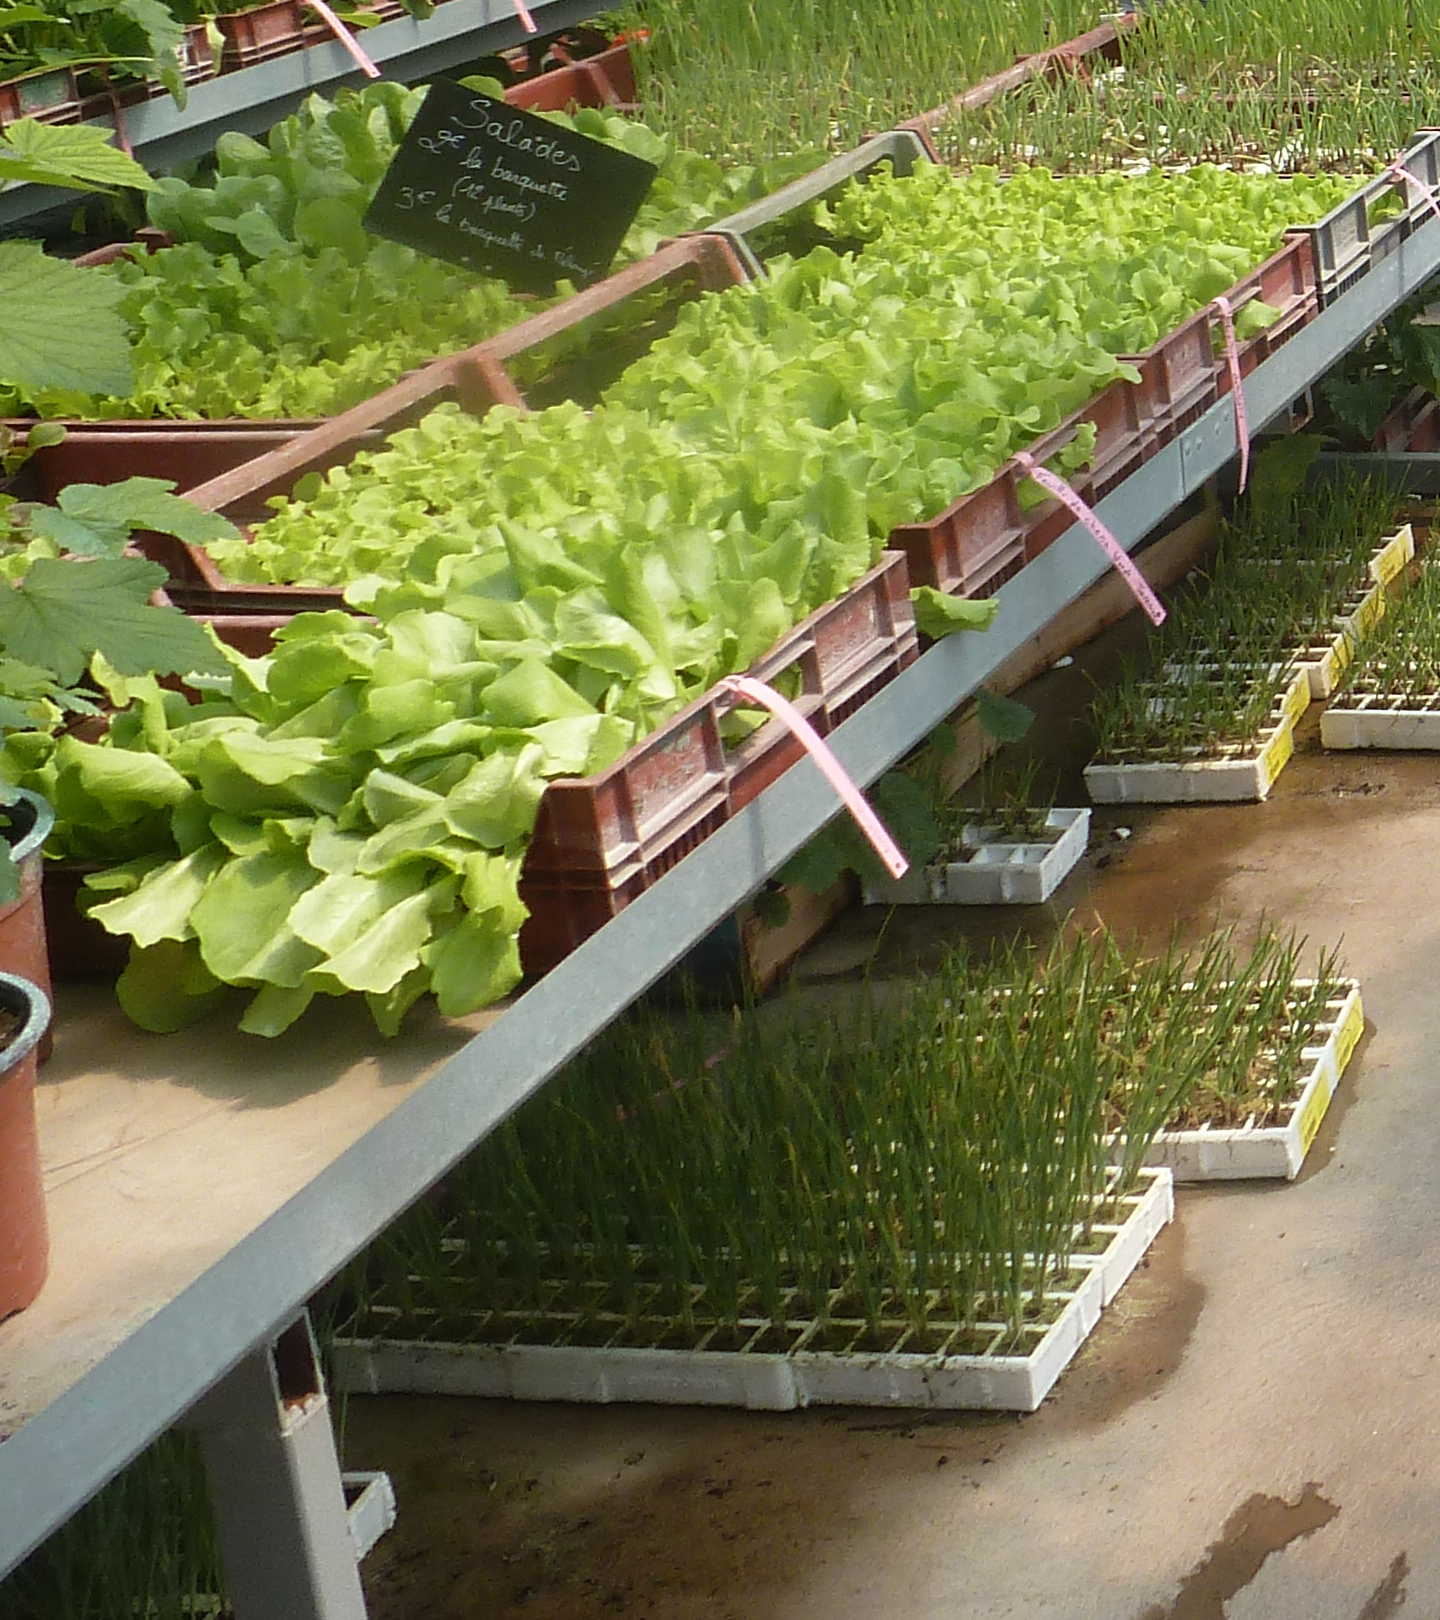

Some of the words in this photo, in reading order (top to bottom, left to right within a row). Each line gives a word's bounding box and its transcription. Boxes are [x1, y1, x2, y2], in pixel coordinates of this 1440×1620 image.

[450, 99, 582, 173] Salades
[394, 186, 436, 210] 3€
[491, 156, 567, 203] barquette
